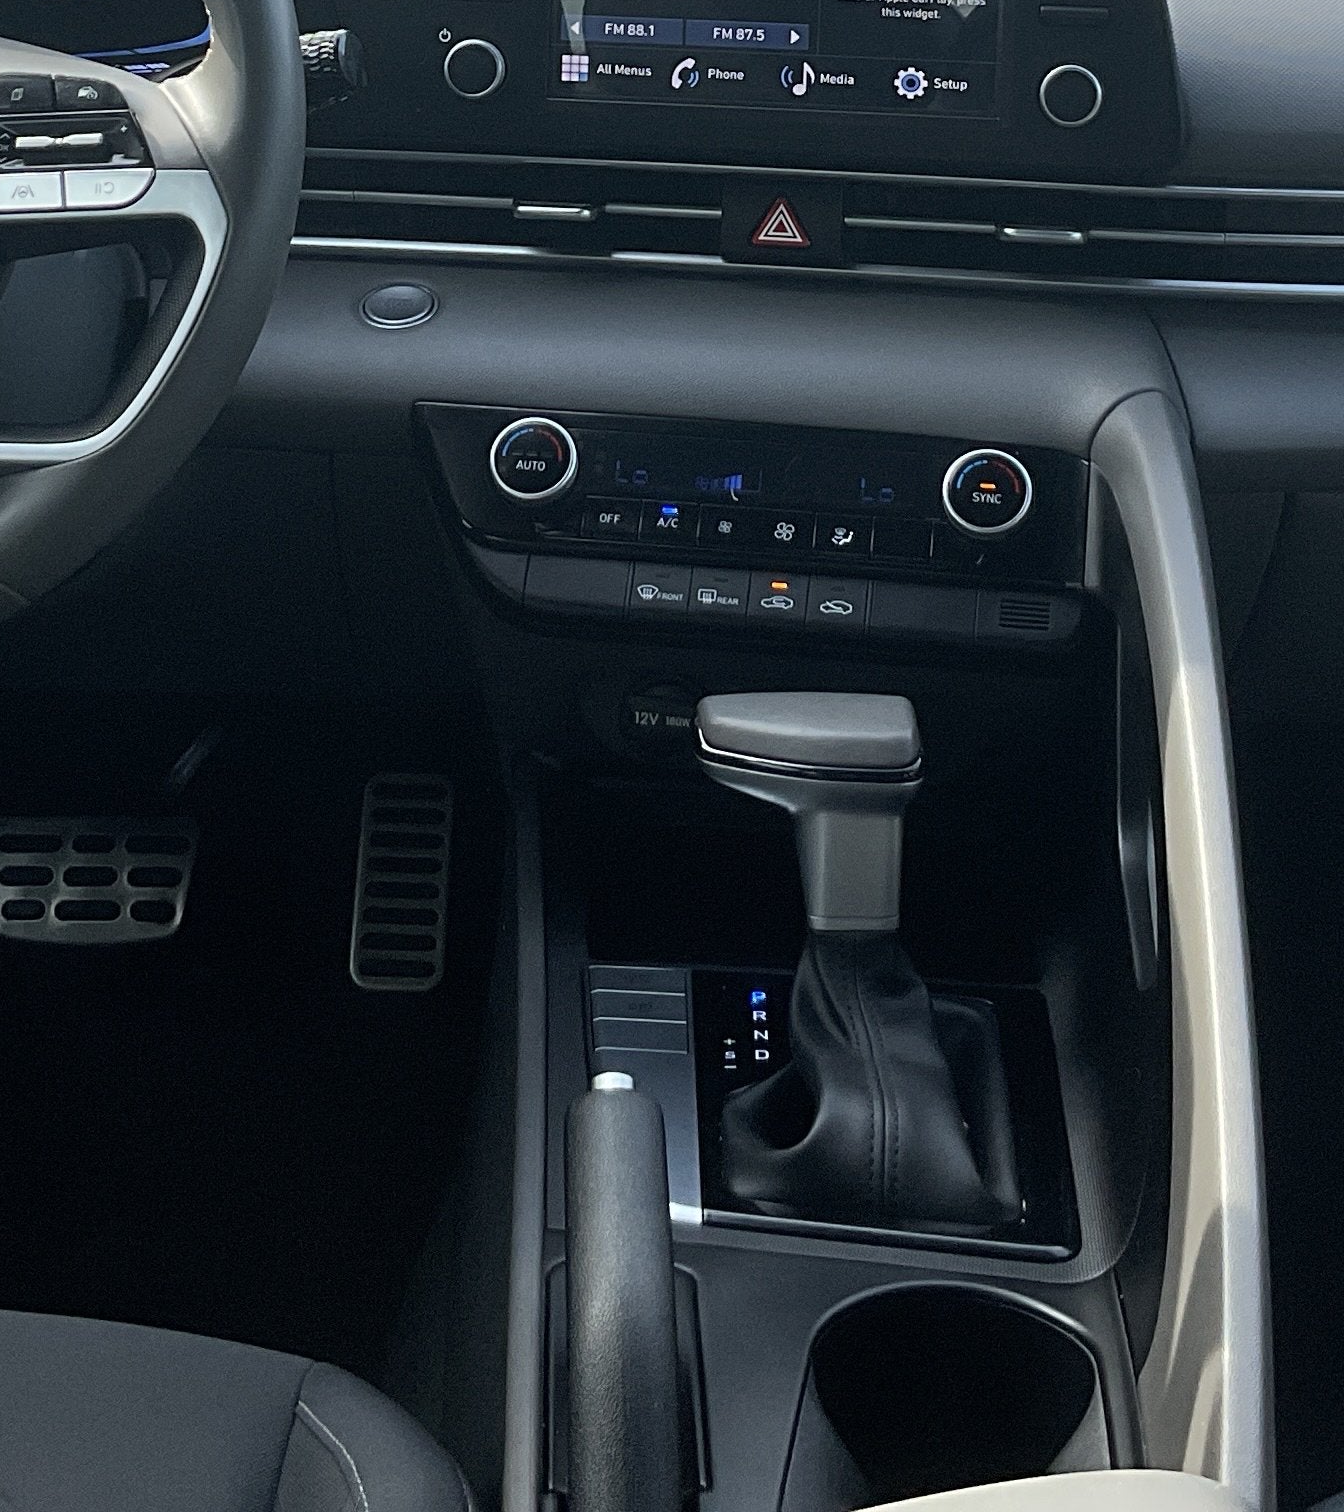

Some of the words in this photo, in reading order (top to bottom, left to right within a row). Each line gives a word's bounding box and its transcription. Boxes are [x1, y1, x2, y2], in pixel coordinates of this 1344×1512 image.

[881, 7, 901, 17] this
[903, 8, 942, 21] widget.
[604, 23, 625, 36] FM
[627, 23, 655, 37] 88.1
[712, 27, 733, 40] FM
[735, 28, 765, 42] 87.5
[596, 63, 612, 75] All
[614, 64, 653, 77] Menus
[707, 68, 745, 81] Phone
[819, 73, 855, 85] Media
[933, 77, 968, 92] Setup
[515, 459, 546, 473] AUTO
[972, 491, 1002, 505] SYNC
[599, 512, 621, 525] OFF
[657, 516, 679, 529] A/C
[656, 591, 684, 601] FRONT
[716, 595, 740, 606] REAR
[634, 710, 660, 726] 12V
[752, 1010, 767, 1021] R
[753, 1029, 769, 1041] N
[755, 1049, 770, 1060] D
